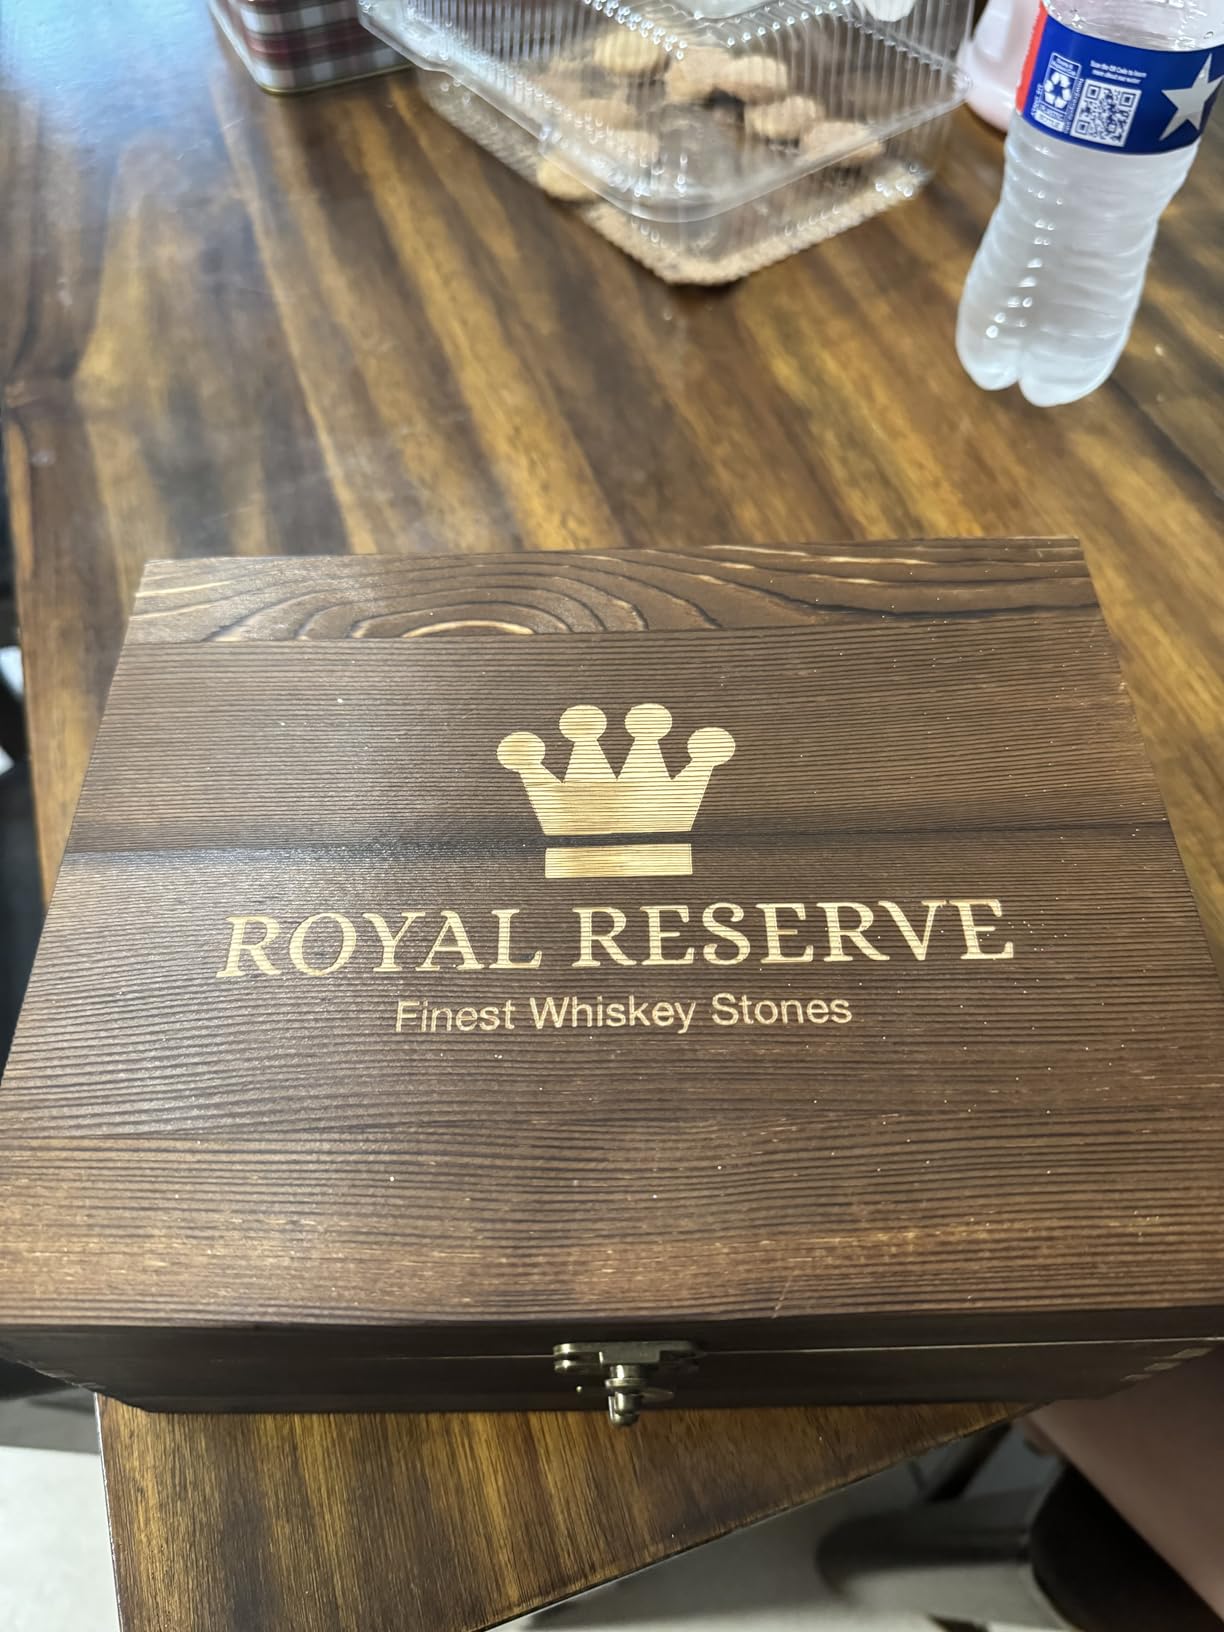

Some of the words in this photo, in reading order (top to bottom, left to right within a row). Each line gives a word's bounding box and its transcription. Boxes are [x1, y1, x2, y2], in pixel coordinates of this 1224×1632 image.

[216, 908, 543, 978] ROYAL
[571, 899, 1015, 968] RESERVE
[394, 998, 516, 1033] Finest
[529, 995, 696, 1034] Whiskey
[711, 991, 853, 1025] Stones
